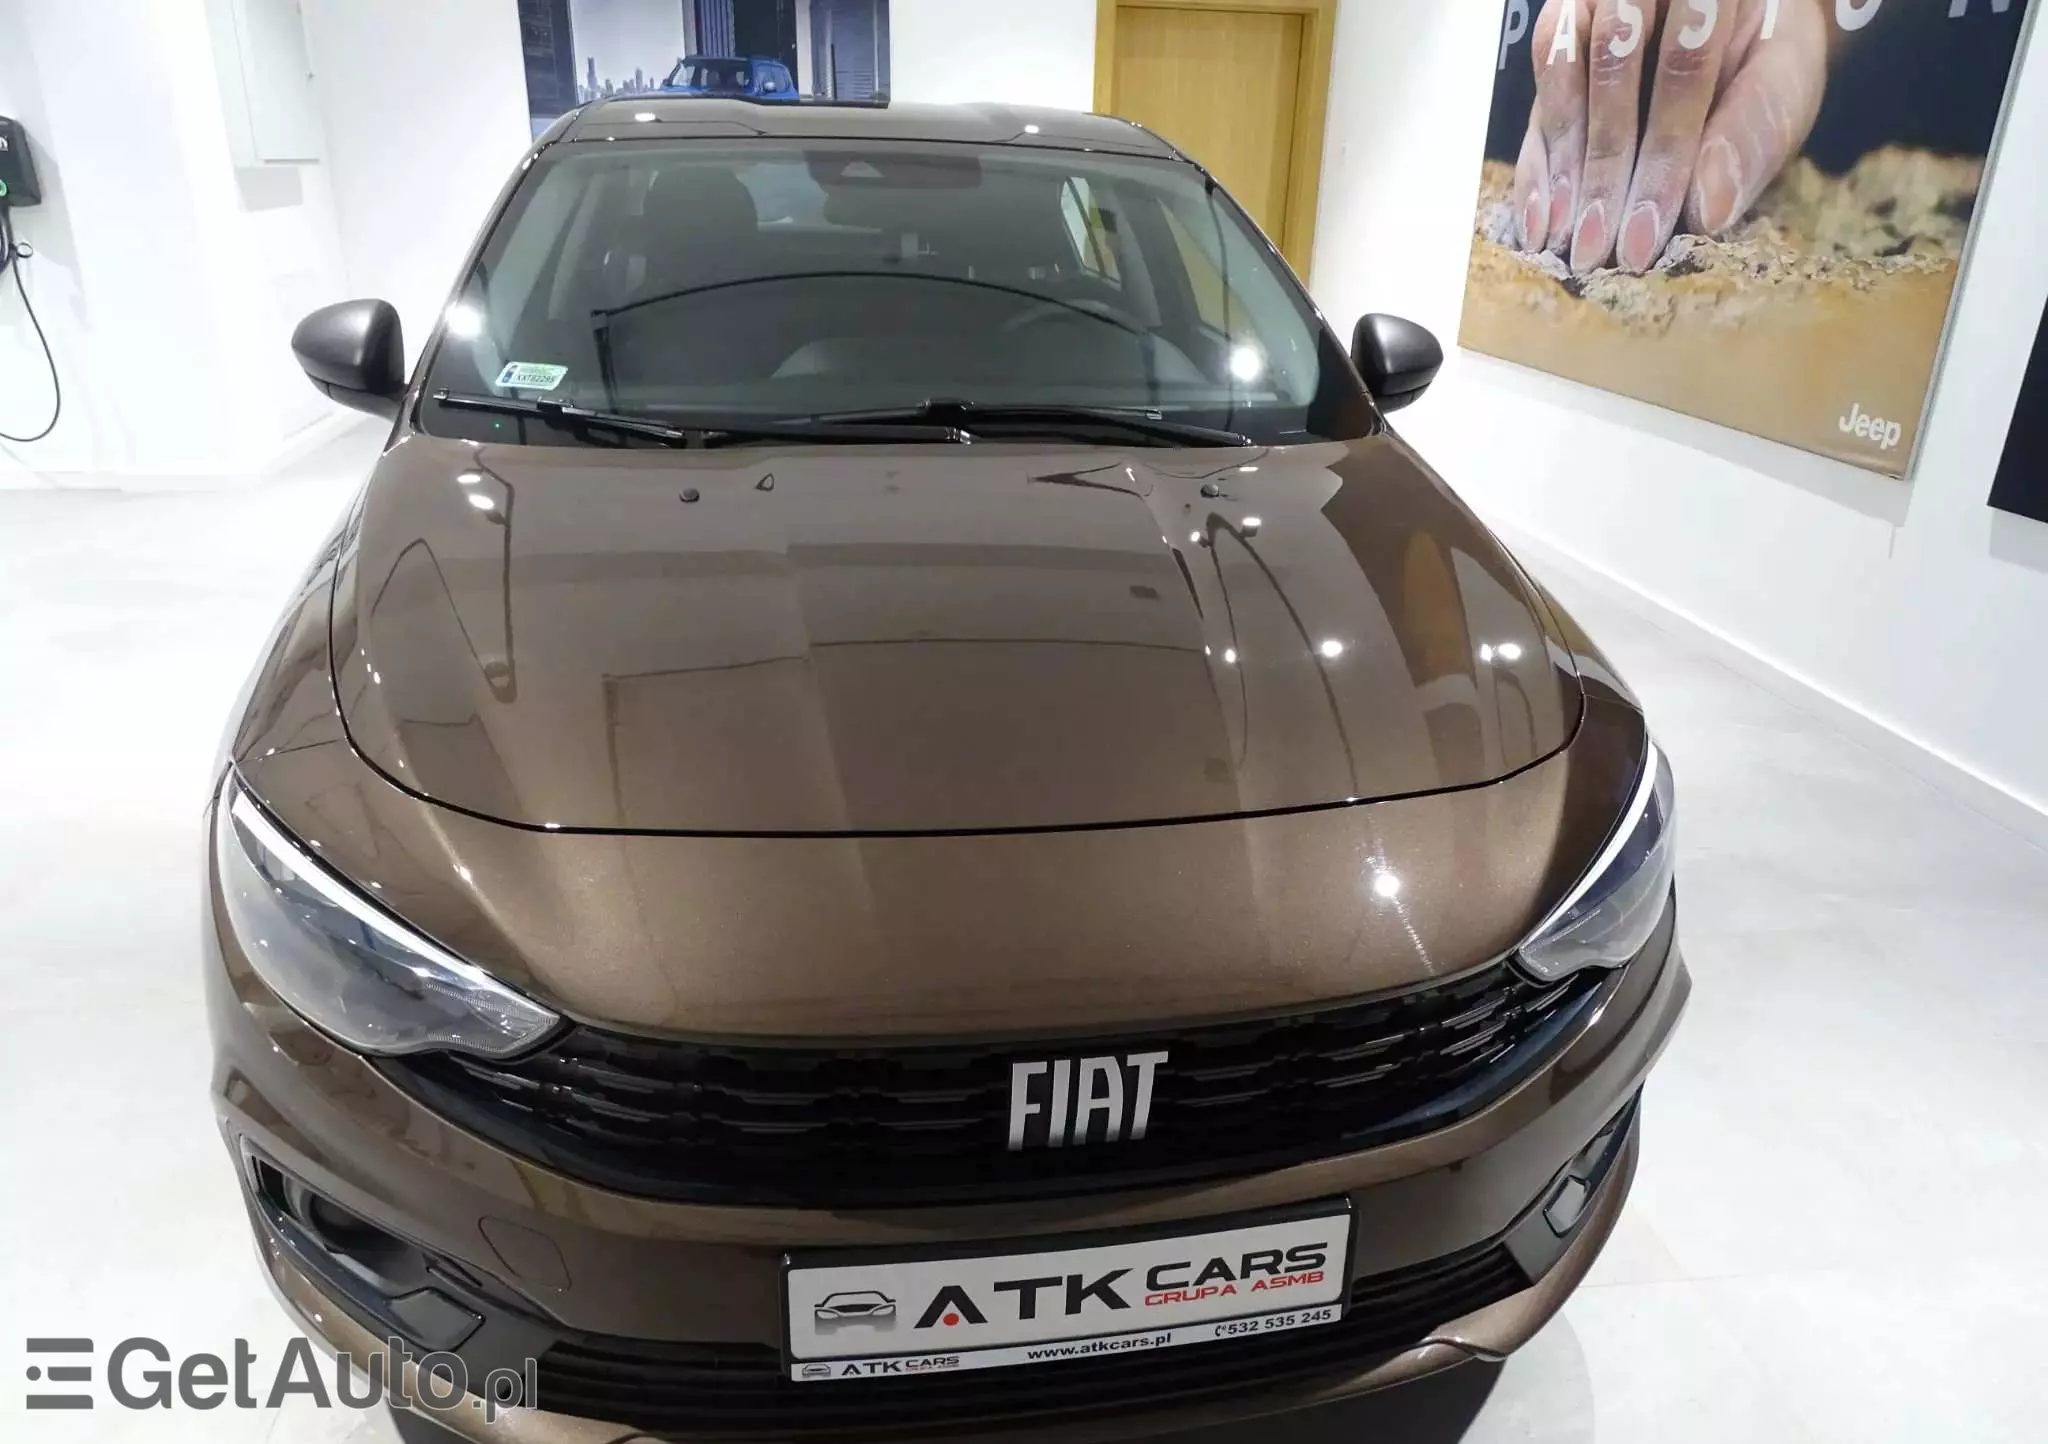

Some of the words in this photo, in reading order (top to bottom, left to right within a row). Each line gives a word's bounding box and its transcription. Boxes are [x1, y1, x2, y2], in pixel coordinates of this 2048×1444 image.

[1498, 0, 2010, 70] PASS
[1838, 402, 1902, 450] Jeep
[1008, 1050, 1169, 1151] FIAT
[913, 1267, 1135, 1329] ATK
[1146, 1241, 1328, 1292] CARS
[1144, 1283, 1238, 1307] GRUPA
[1250, 1270, 1325, 1293] ASMB
[1227, 1320, 1259, 1336] 532
[1264, 1314, 1296, 1330] 535
[1301, 1308, 1332, 1324] 245
[841, 1360, 902, 1376] ATK
[905, 1355, 960, 1369] CARS
[1027, 1332, 1172, 1360] www.atkcars.pl
